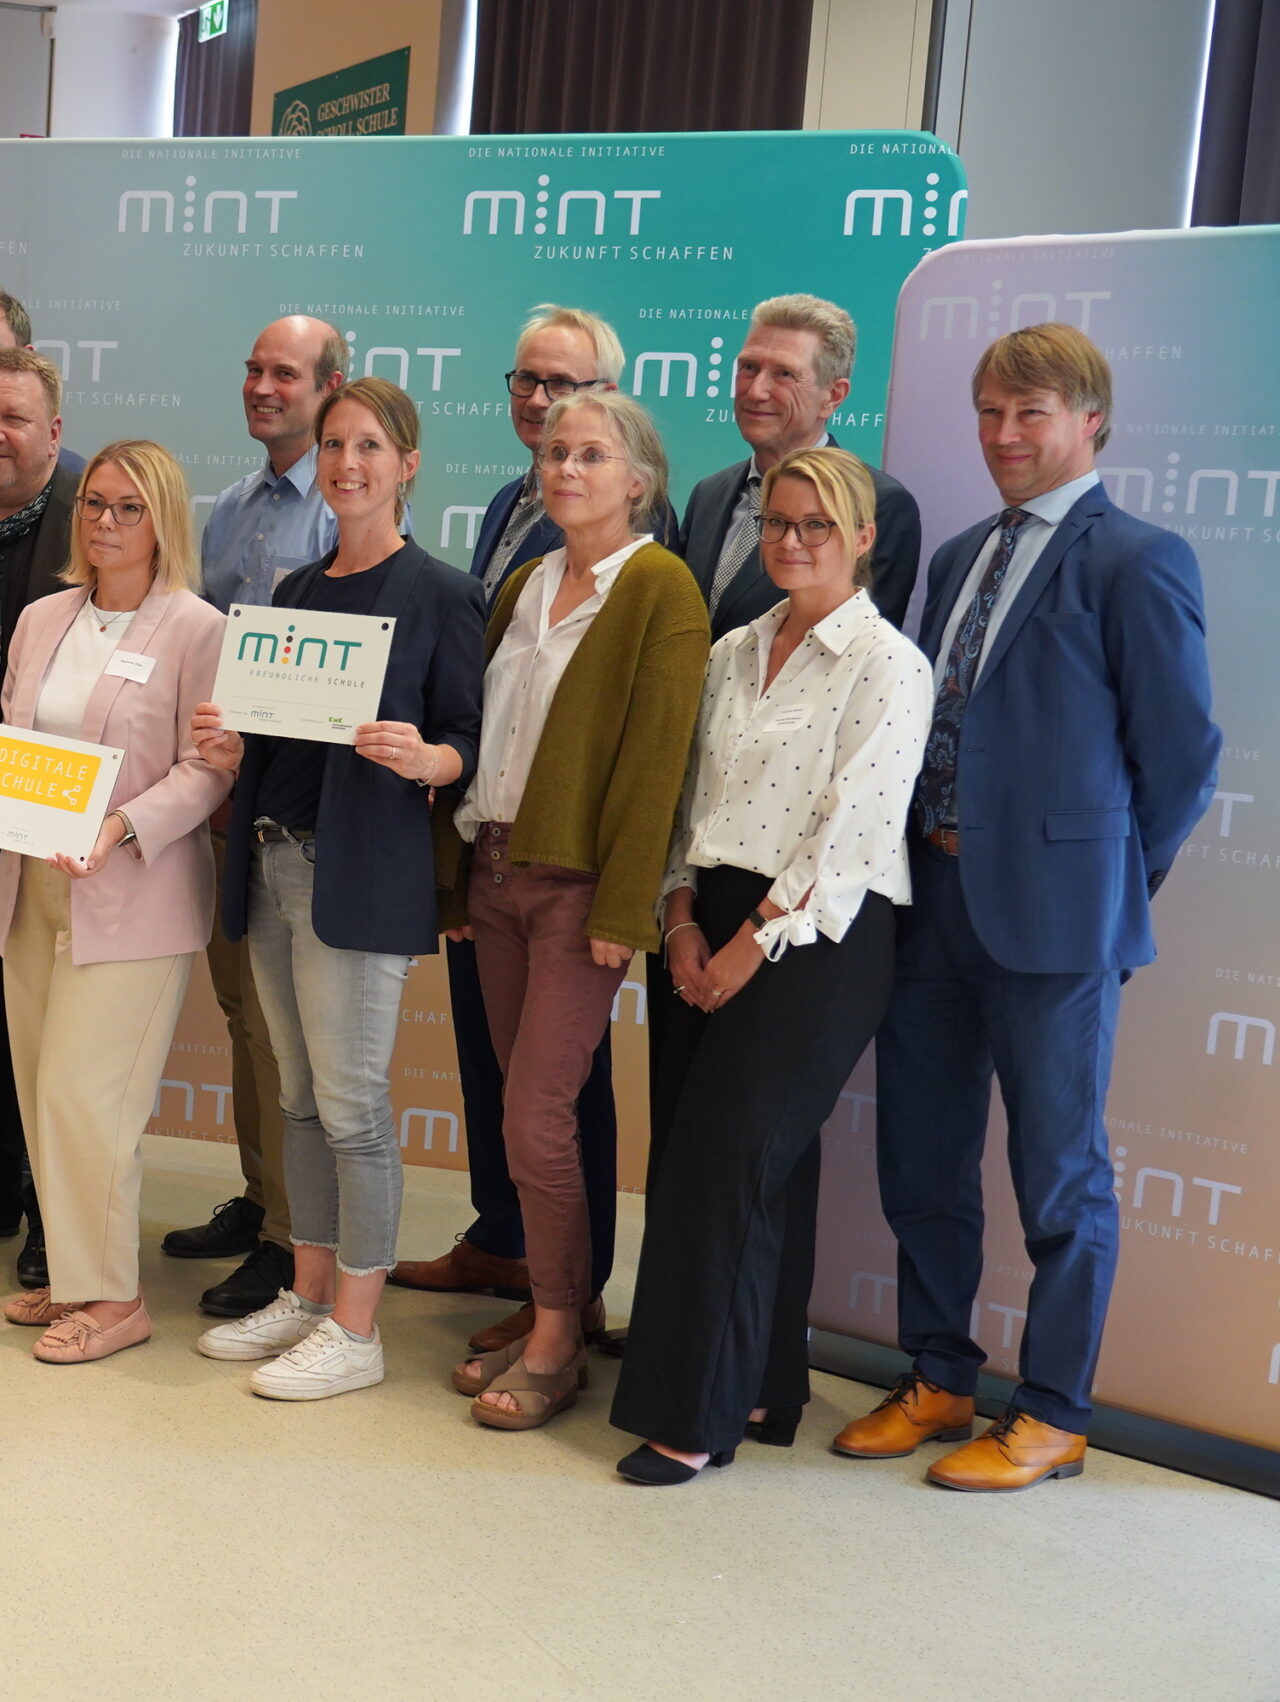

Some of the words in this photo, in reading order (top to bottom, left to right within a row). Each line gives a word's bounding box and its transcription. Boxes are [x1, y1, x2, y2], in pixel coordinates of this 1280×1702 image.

[317, 82, 390, 122] GESCHWISTER
[356, 106, 399, 136] SCHULE
[121, 149, 143, 159] DIE
[148, 149, 218, 160] NATIONALE
[224, 149, 302, 160] INITIATIVE
[468, 147, 492, 158] DIE
[497, 146, 574, 158] NATIONALE
[579, 145, 666, 158] INITIATIVE
[849, 143, 875, 155] DIE
[183, 243, 264, 257] ZUKUNFT
[270, 243, 365, 258] SCHAFFEN
[533, 245, 622, 260] ZUKUNFT
[629, 246, 734, 261] SCHAFFEN
[1032, 247, 1118, 262] INITIATIVE
[48, 299, 121, 311] INITIATIVE
[279, 303, 301, 314] DIE
[307, 303, 378, 315] NATIONALE
[385, 304, 465, 316] INITIATIVE
[639, 308, 663, 319] DIE
[669, 308, 749, 320] NATIONALE
[91, 391, 181, 407] SCHAFFEN
[1126, 423, 1206, 436] NATIONALE
[446, 463, 468, 474] DIE
[249, 669, 320, 684] FREUNDLICHE
[327, 677, 366, 689] SCHULE
[1215, 967, 1240, 981] DIE
[404, 1067, 426, 1078] DIE
[1159, 1126, 1248, 1156] INITIATIVE
